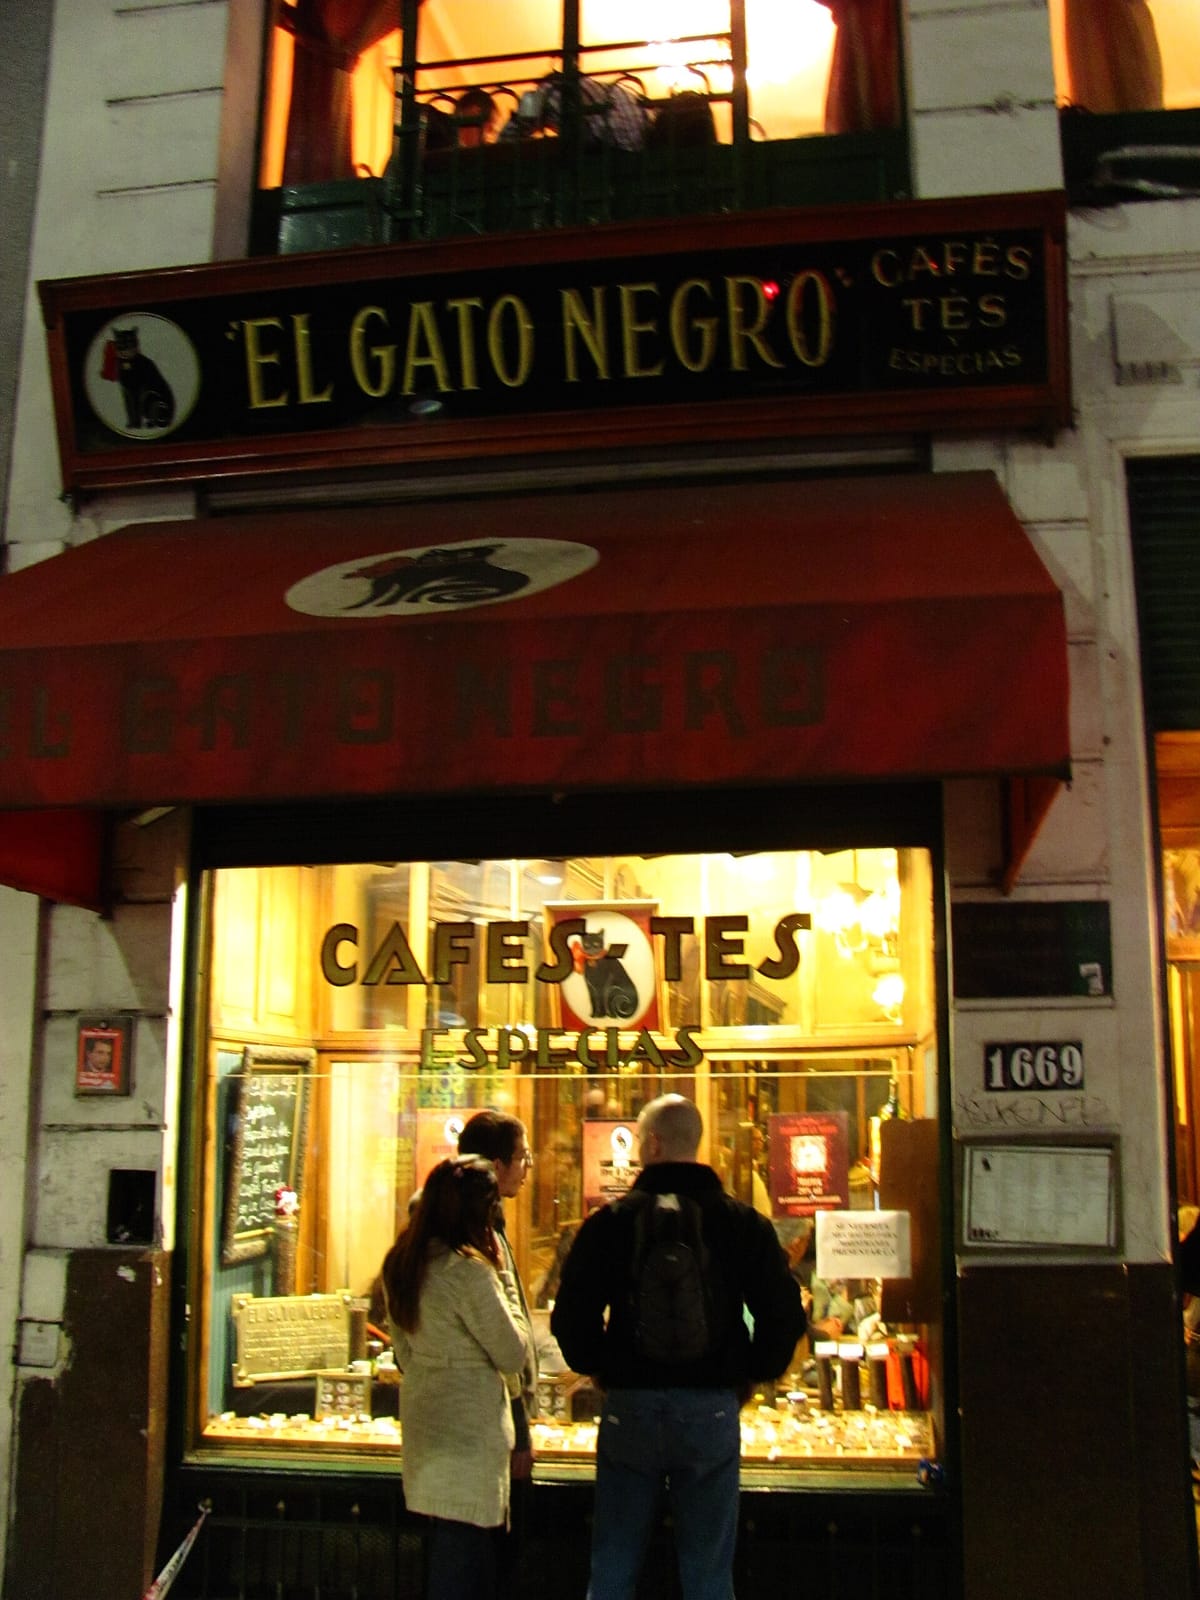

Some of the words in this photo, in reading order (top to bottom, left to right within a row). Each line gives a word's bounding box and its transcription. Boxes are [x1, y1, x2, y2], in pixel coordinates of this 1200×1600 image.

[348, 291, 536, 399] GATO
[887, 344, 1024, 375] ESPECIAS
[455, 648, 826, 740] NEGRO
[320, 918, 587, 987] CAFES
[650, 912, 812, 981] TES
[420, 1025, 705, 1071] ESPECIAS
[987, 1043, 1084, 1090] 1669
